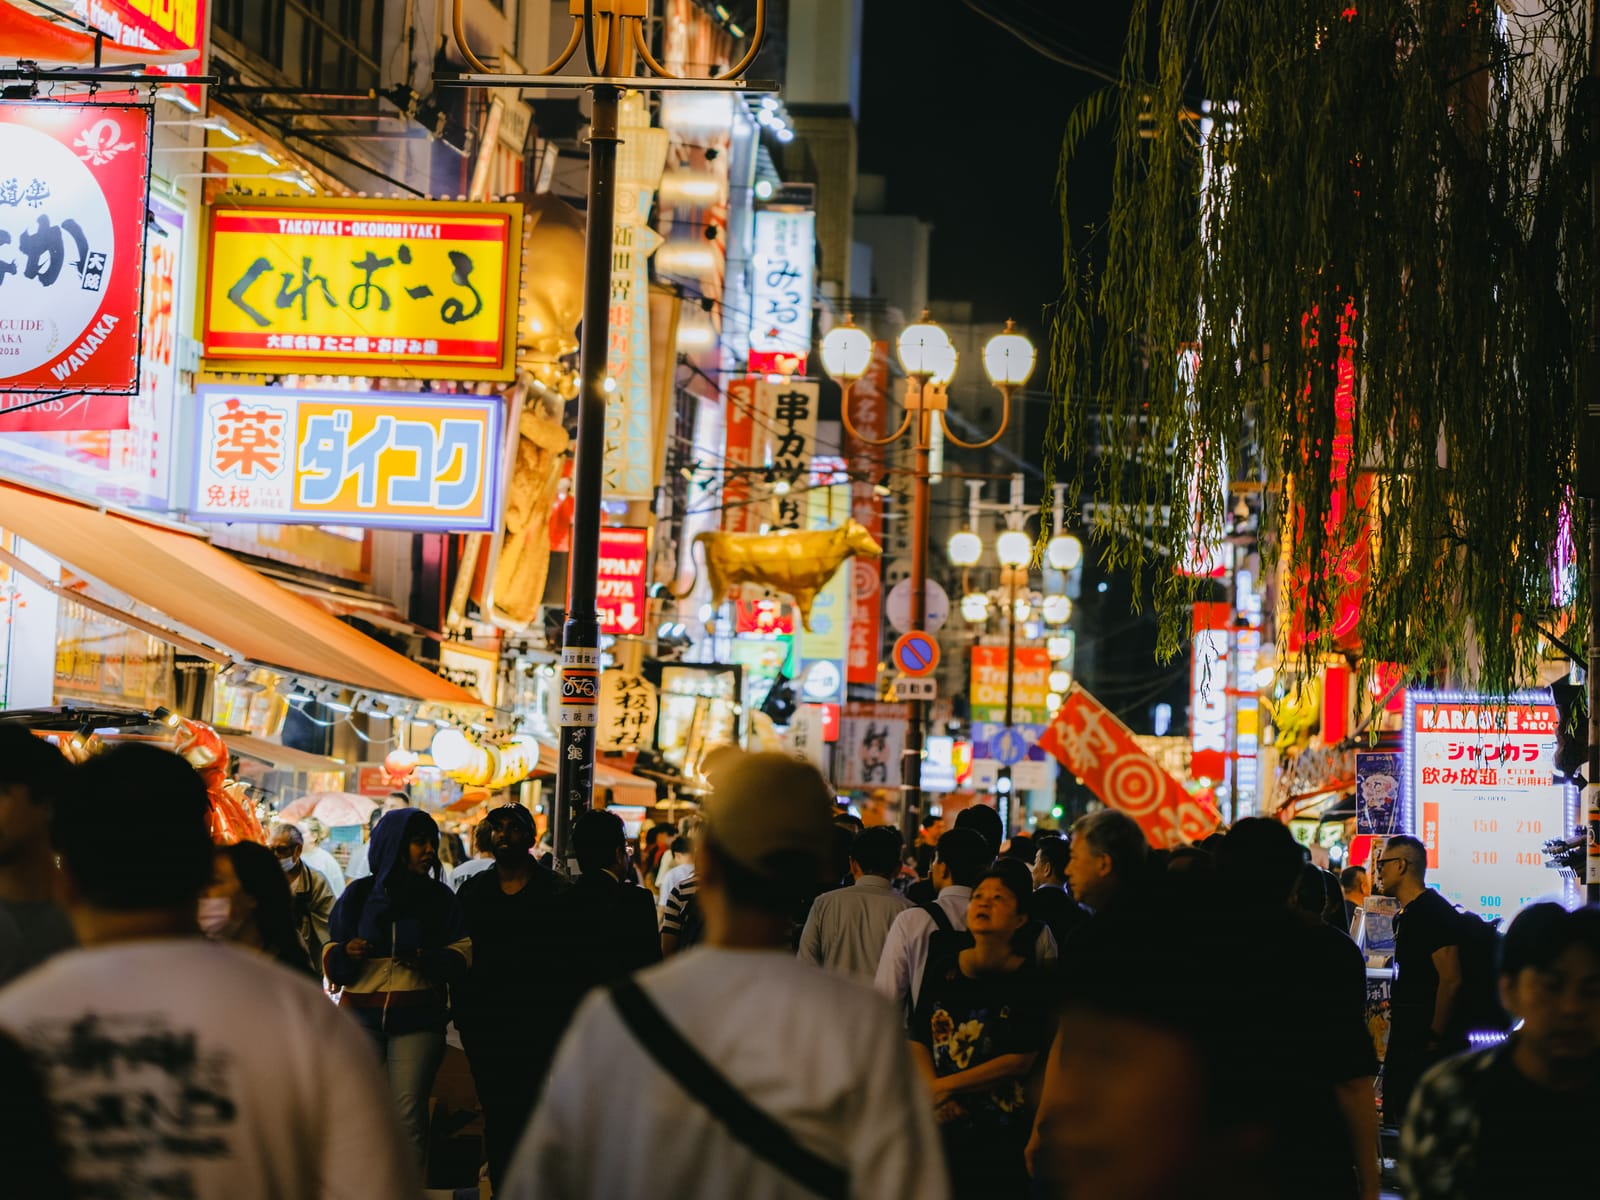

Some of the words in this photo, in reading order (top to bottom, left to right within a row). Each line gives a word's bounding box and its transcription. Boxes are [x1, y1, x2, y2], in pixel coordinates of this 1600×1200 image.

[227, 244, 483, 327] くれおーる
[51, 312, 119, 382] WANAKA
[217, 398, 283, 475] 薬
[300, 412, 483, 508] ダイコク
[207, 484, 250, 508] 免税
[1448, 742, 1539, 762] ジャンカラ
[1473, 819, 1497, 833] 150
[1516, 820, 1541, 834] 210
[1472, 851, 1497, 865] 310
[1514, 852, 1541, 866] 440
[1480, 895, 1501, 907] 900
